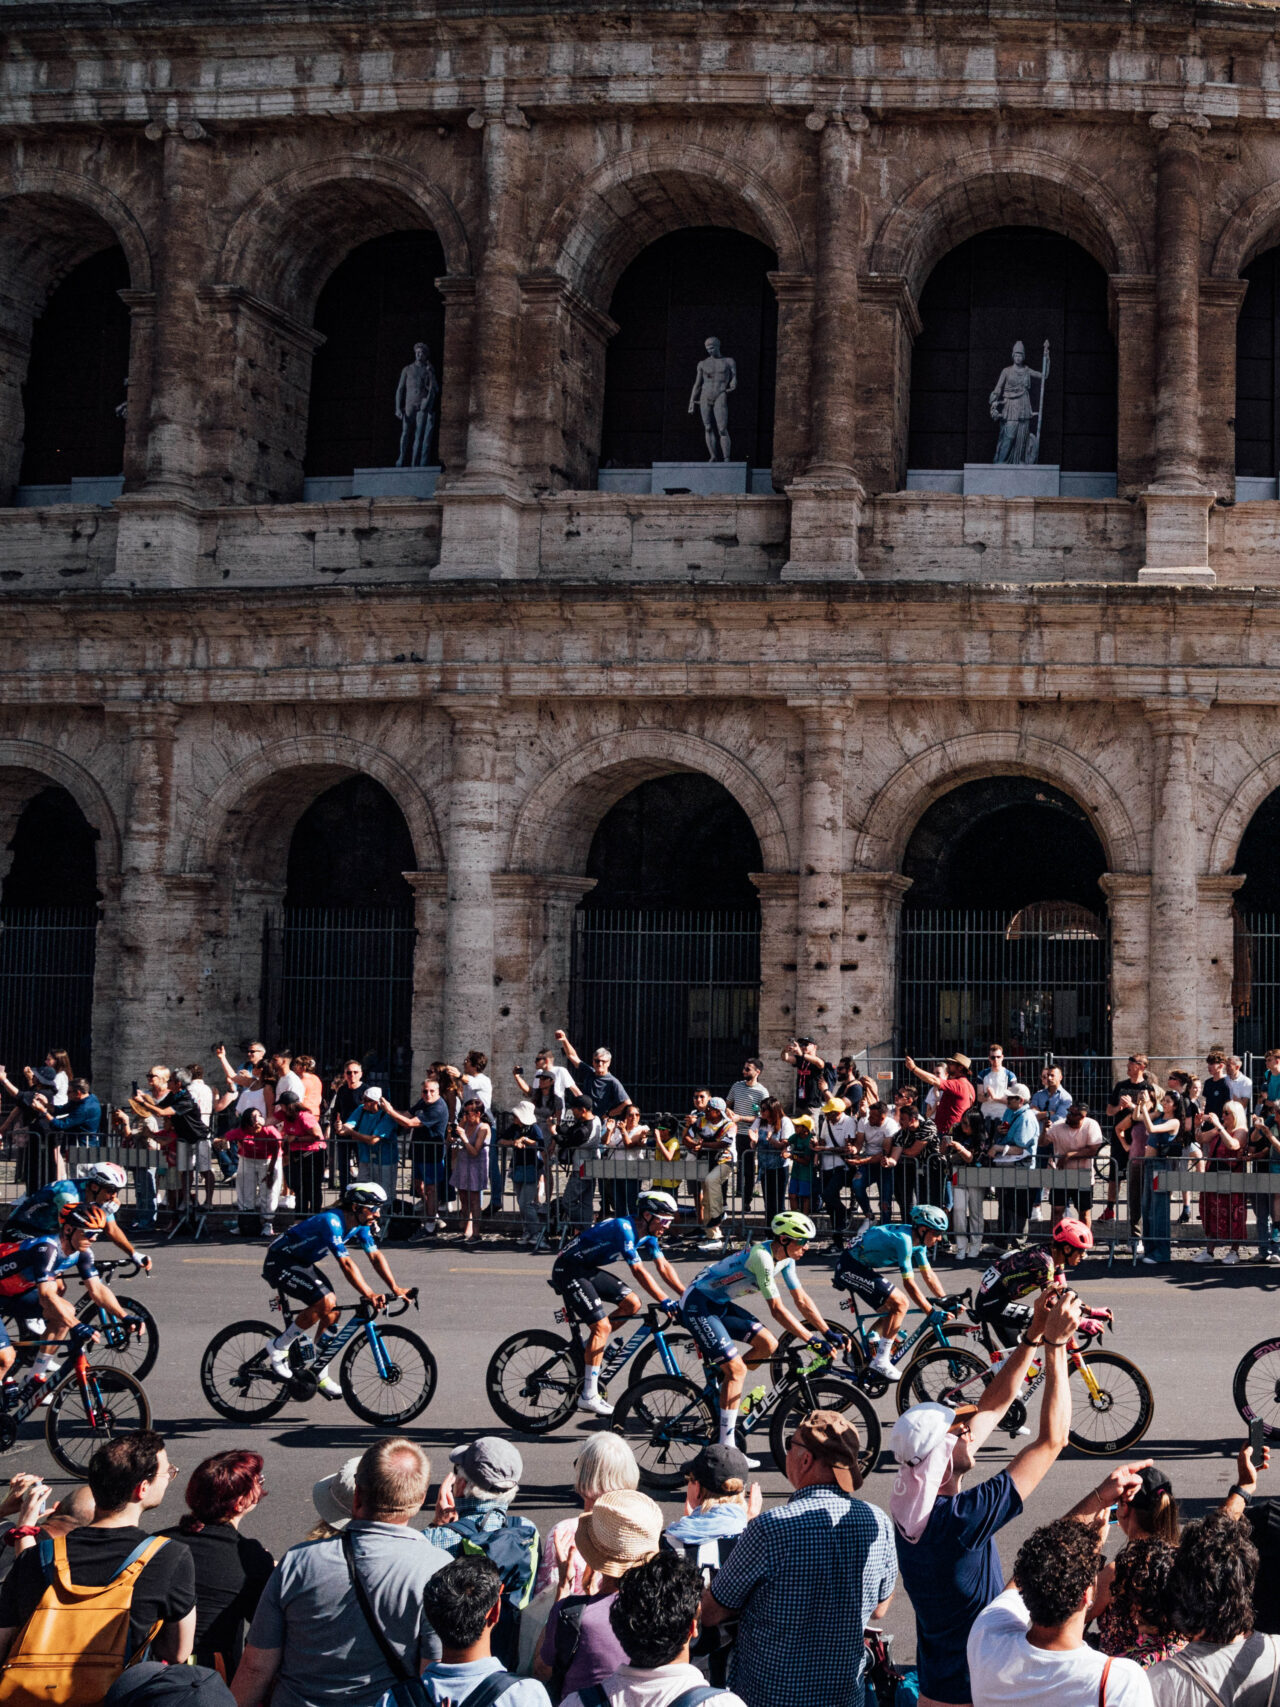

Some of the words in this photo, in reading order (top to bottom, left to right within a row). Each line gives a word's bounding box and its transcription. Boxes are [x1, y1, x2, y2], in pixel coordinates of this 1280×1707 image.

[845, 1271, 875, 1289] ASTANA
[982, 1269, 997, 1286] 72
[1002, 1302, 1028, 1319] EF
[313, 1325, 359, 1370] CANYON
[601, 1333, 647, 1379] CANYON
[742, 1377, 790, 1431] CUBE
